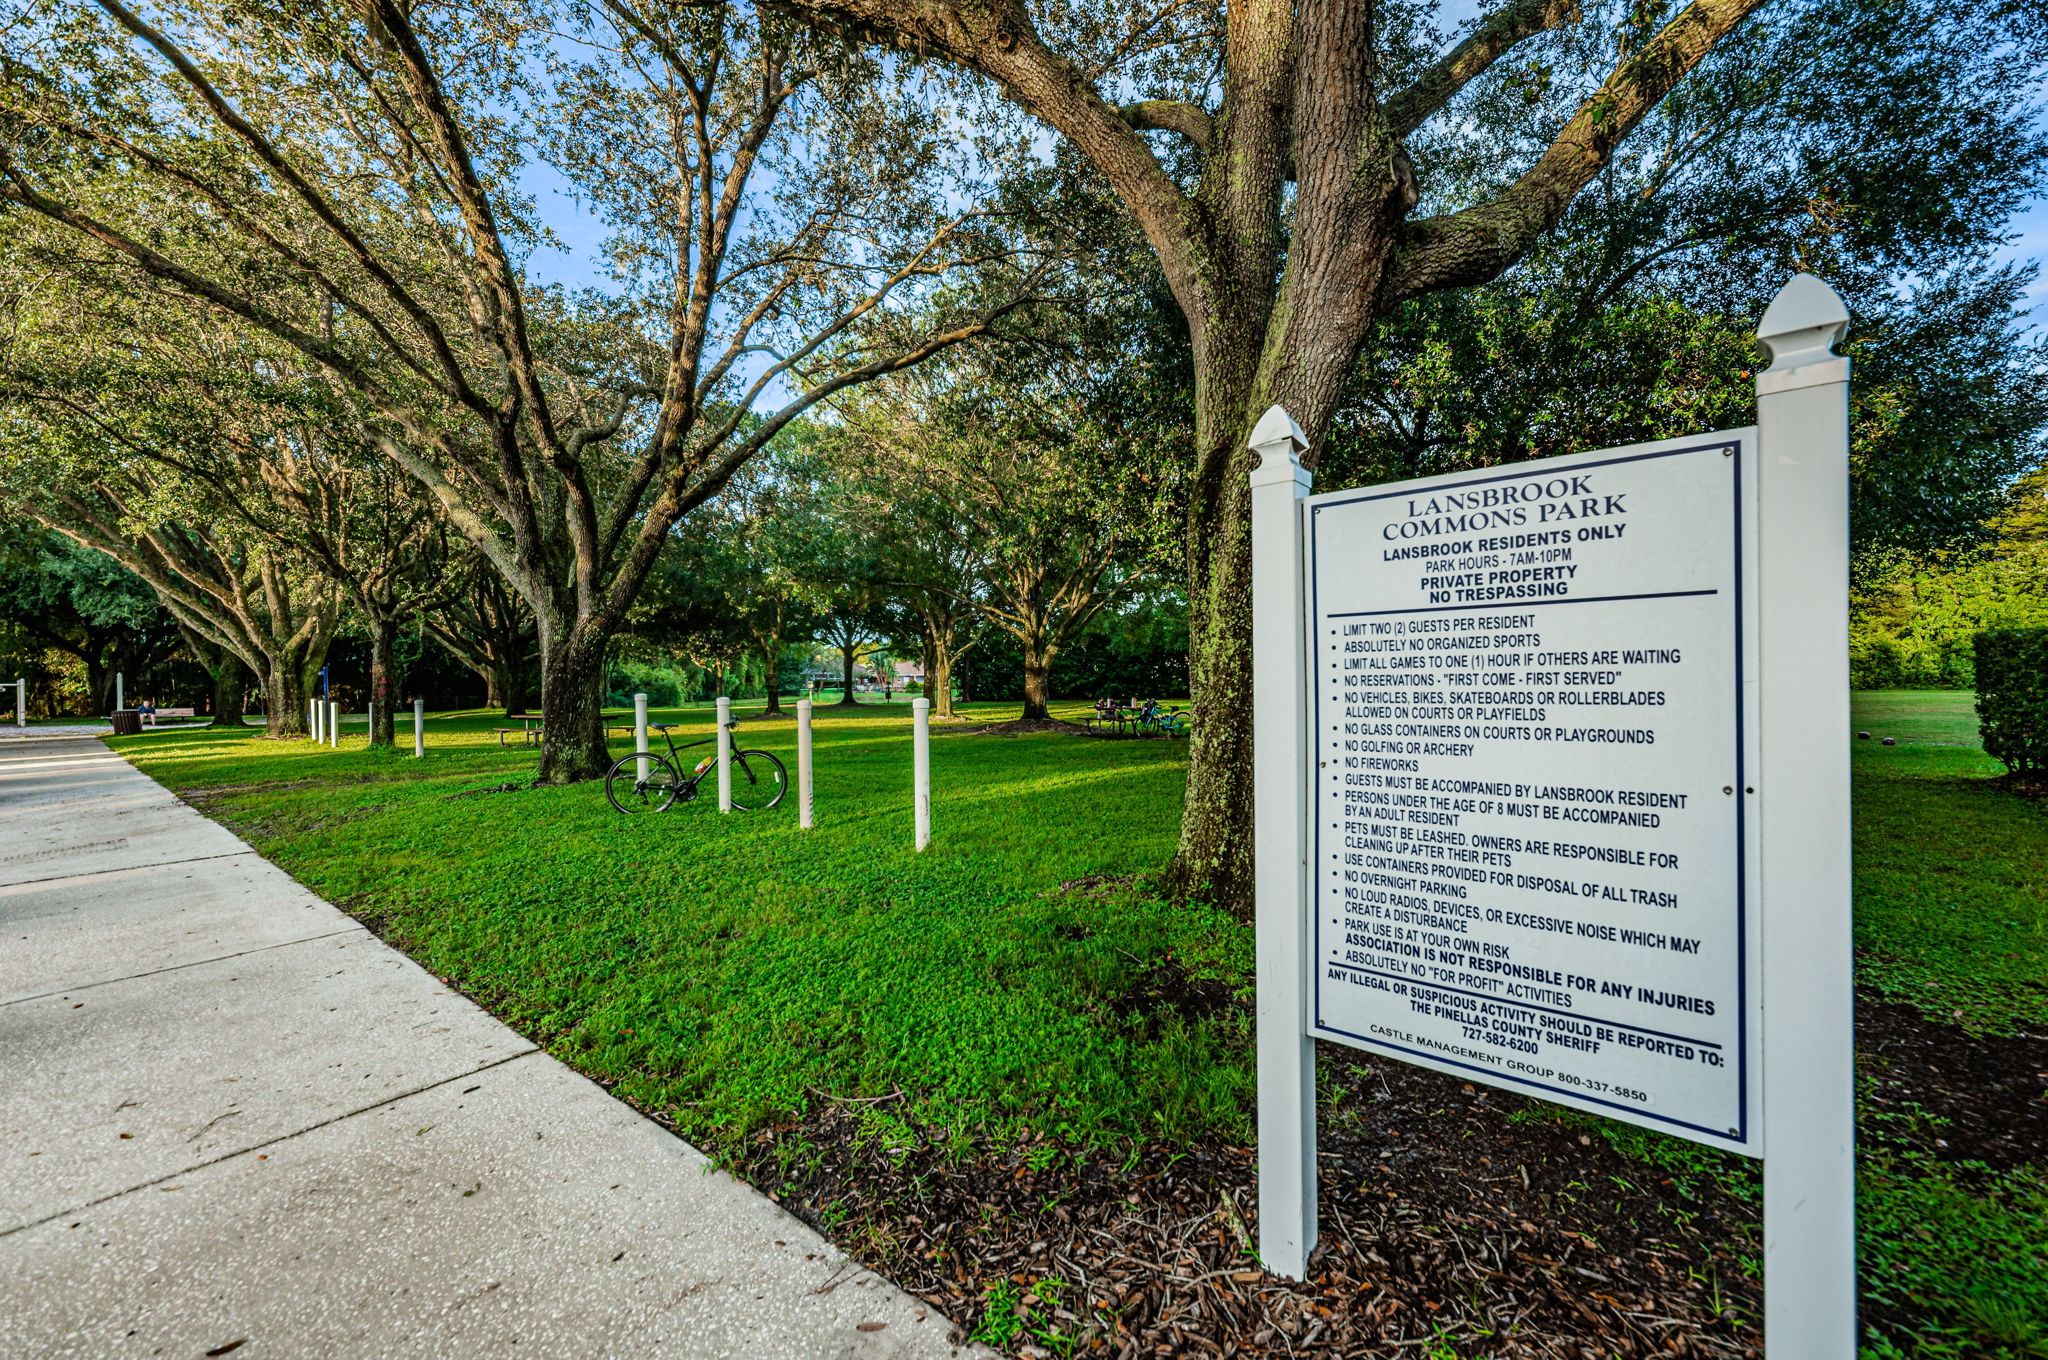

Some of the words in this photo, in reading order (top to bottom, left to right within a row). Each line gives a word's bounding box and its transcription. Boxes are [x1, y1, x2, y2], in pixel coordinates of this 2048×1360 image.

[1408, 475, 1593, 518] LANSBROOK
[1382, 507, 1526, 541] COMMONS
[1538, 493, 1627, 523] PARK
[1383, 539, 1473, 562] LANSBROOK
[1478, 529, 1572, 552] RESIDENTS
[1576, 522, 1626, 542] ONLY
[1420, 572, 1483, 590] PRIVATE
[1488, 563, 1578, 585] PROPERTY
[1425, 558, 1455, 573] PARK
[1458, 554, 1499, 570] HOURS
[1509, 546, 1572, 566] 7AM-10PM
[1429, 590, 1451, 604] NO
[1454, 580, 1568, 602] TRESPASSING
[1343, 623, 1367, 636] LIMIT
[1368, 621, 1392, 635] TWO
[1393, 621, 1406, 636] (2)
[1408, 618, 1450, 633] GUESTS
[1452, 617, 1475, 631] PER
[1478, 613, 1535, 630] RESIDENT
[1343, 638, 1406, 653] ABSOLUTELY
[1408, 638, 1424, 651] NO
[1426, 635, 1490, 650] ORGANIZED
[1492, 632, 1540, 648] SPORTS
[1343, 657, 1368, 670] LIMIT
[1368, 657, 1387, 669] ALL
[1389, 655, 1426, 669] GAMES
[1427, 655, 1442, 668] TO
[1444, 654, 1468, 668] ONE
[1470, 654, 1484, 670] (1)
[1487, 653, 1520, 667] HOUR
[1523, 652, 1534, 666] IF
[1536, 650, 1588, 666] OTHERS
[1590, 650, 1619, 665] ARE
[1621, 648, 1681, 664] WAITING
[1344, 674, 1358, 687] NO
[1360, 673, 1434, 686] RESERVATIONS
[1443, 672, 1479, 686] "FIRST
[1482, 672, 1515, 686] COME
[1525, 671, 1560, 686] FIRST
[1563, 670, 1622, 685] SERVED"
[1344, 691, 1358, 704] NO
[1359, 691, 1410, 704] VEHICLES,
[1412, 691, 1446, 704] BIKES,
[1449, 690, 1534, 705] SKATEBOARDS
[1536, 690, 1555, 705] OR
[1558, 690, 1666, 706] ROLLERBLADES
[1344, 705, 1392, 718] ALLOWED
[1394, 706, 1409, 718] ON
[1411, 706, 1454, 720] COURTS
[1456, 706, 1473, 720] OR
[1476, 706, 1546, 722] PLAYFIELDS
[1344, 722, 1358, 735] NO
[1360, 722, 1393, 736] GLASS
[1394, 723, 1461, 738] CONTAINERS
[1463, 725, 1480, 739] ON
[1482, 725, 1531, 741] COURTS
[1533, 726, 1552, 741] OR
[1555, 727, 1655, 744] PLAYGROUNDS
[1344, 739, 1358, 752] NO
[1360, 739, 1404, 754] GOLFING
[1405, 741, 1421, 754] OR
[1422, 742, 1474, 757] ARCHERY
[1344, 756, 1358, 768] NO
[1360, 756, 1419, 772] FIREWORKS
[1344, 772, 1382, 787] GUESTS
[1384, 775, 1412, 789] MUST
[1414, 777, 1429, 791] BE
[1430, 778, 1512, 797] ACCOMPANIED
[1514, 783, 1531, 798] BY
[1534, 785, 1614, 804] LANSBROOK
[1617, 790, 1688, 809] RESIDENT
[1344, 789, 1389, 805] PERSONS
[1392, 793, 1427, 808] UNDER
[1429, 796, 1450, 810] THE
[1452, 798, 1476, 813] AGE
[1478, 800, 1494, 814] OF
[1496, 801, 1504, 815] 8
[1506, 802, 1540, 818] MUST
[1542, 804, 1560, 820] BE
[1562, 806, 1660, 828] ACCOMPANIED
[1344, 820, 1368, 835] PETS
[1370, 823, 1397, 838] MUST
[1400, 826, 1413, 840] BE
[1416, 828, 1468, 846] LEASHED.
[1471, 834, 1522, 852] OWNERS
[1524, 839, 1550, 856] ARE
[1553, 842, 1645, 866] RESPONSIBLE
[1648, 851, 1678, 870] FOR
[1344, 835, 1393, 853] CLEANING
[1395, 841, 1409, 854] UP
[1410, 843, 1444, 859] AFTER
[1446, 846, 1479, 864] THEIR
[1482, 850, 1512, 868] PETS
[1344, 852, 1363, 866] USE
[1365, 854, 1428, 875] CONTAINERS
[1431, 863, 1487, 883] PROVIDED
[1489, 870, 1514, 887] FOR
[1516, 874, 1579, 896] DISPOSAL
[1581, 882, 1599, 898] OF
[1601, 885, 1628, 902] ALL
[1629, 888, 1677, 909] TRASH
[1344, 900, 1382, 918] CREATE
[1383, 907, 1391, 920] A
[1393, 908, 1468, 934] DISTURBANCE
[1344, 886, 1358, 900] NO
[1360, 888, 1387, 904] LOUD
[1389, 892, 1430, 912] RADIOS,
[1433, 899, 1483, 922] DEVICES,
[1485, 907, 1503, 924] OR
[1505, 910, 1573, 935] EXCESSIVE
[1576, 921, 1617, 942] NOISE
[1619, 928, 1666, 950] WHICH
[1670, 935, 1701, 955] MAY
[1344, 917, 1370, 933] PARK
[1372, 922, 1391, 938] USE
[1394, 926, 1403, 940] IS
[1405, 928, 1418, 942] AT
[1420, 931, 1451, 949] YOUR
[1453, 937, 1480, 954] OWN
[1482, 942, 1510, 960] RISK
[1344, 932, 1420, 958] ASSOCIATION
[1424, 947, 1436, 961] IS
[1439, 950, 1465, 967] NOT
[1468, 955, 1562, 986] RESPONSIBLE
[1566, 973, 1596, 993] FOR
[1600, 980, 1633, 1000] ANY
[1637, 987, 1715, 1016] INJURIES
[1344, 949, 1408, 973] ABSOLUTELY
[1410, 962, 1426, 977] NO
[1428, 966, 1455, 984] "FOR
[1458, 972, 1504, 992] PROFIT"
[1506, 982, 1572, 1008] ACTIVITIES
[1327, 967, 1347, 982] ANY
[1349, 972, 1391, 992] ILLEGAL
[1392, 982, 1408, 996] OR
[1410, 985, 1477, 1012] SUSPICIOUS
[1479, 1001, 1536, 1024] ACTIVITY
[1538, 1014, 1592, 1037] SHOULD
[1595, 1026, 1614, 1043] BE
[1617, 1031, 1695, 1060] REPORTED
[1698, 1048, 1724, 1068] TO:
[1409, 999, 1431, 1015] THE
[1434, 1004, 1488, 1028] PINELLAS
[1491, 1018, 1543, 1041] COUNTY
[1545, 1030, 1600, 1054] SHERIFF
[1461, 1025, 1538, 1055] 727-582-6200
[1369, 1023, 1413, 1043] CASTLE
[1416, 1035, 1502, 1065] MANAGEMENT
[1506, 1059, 1554, 1078] GROUP
[1557, 1071, 1647, 1102] 800-337-5850
